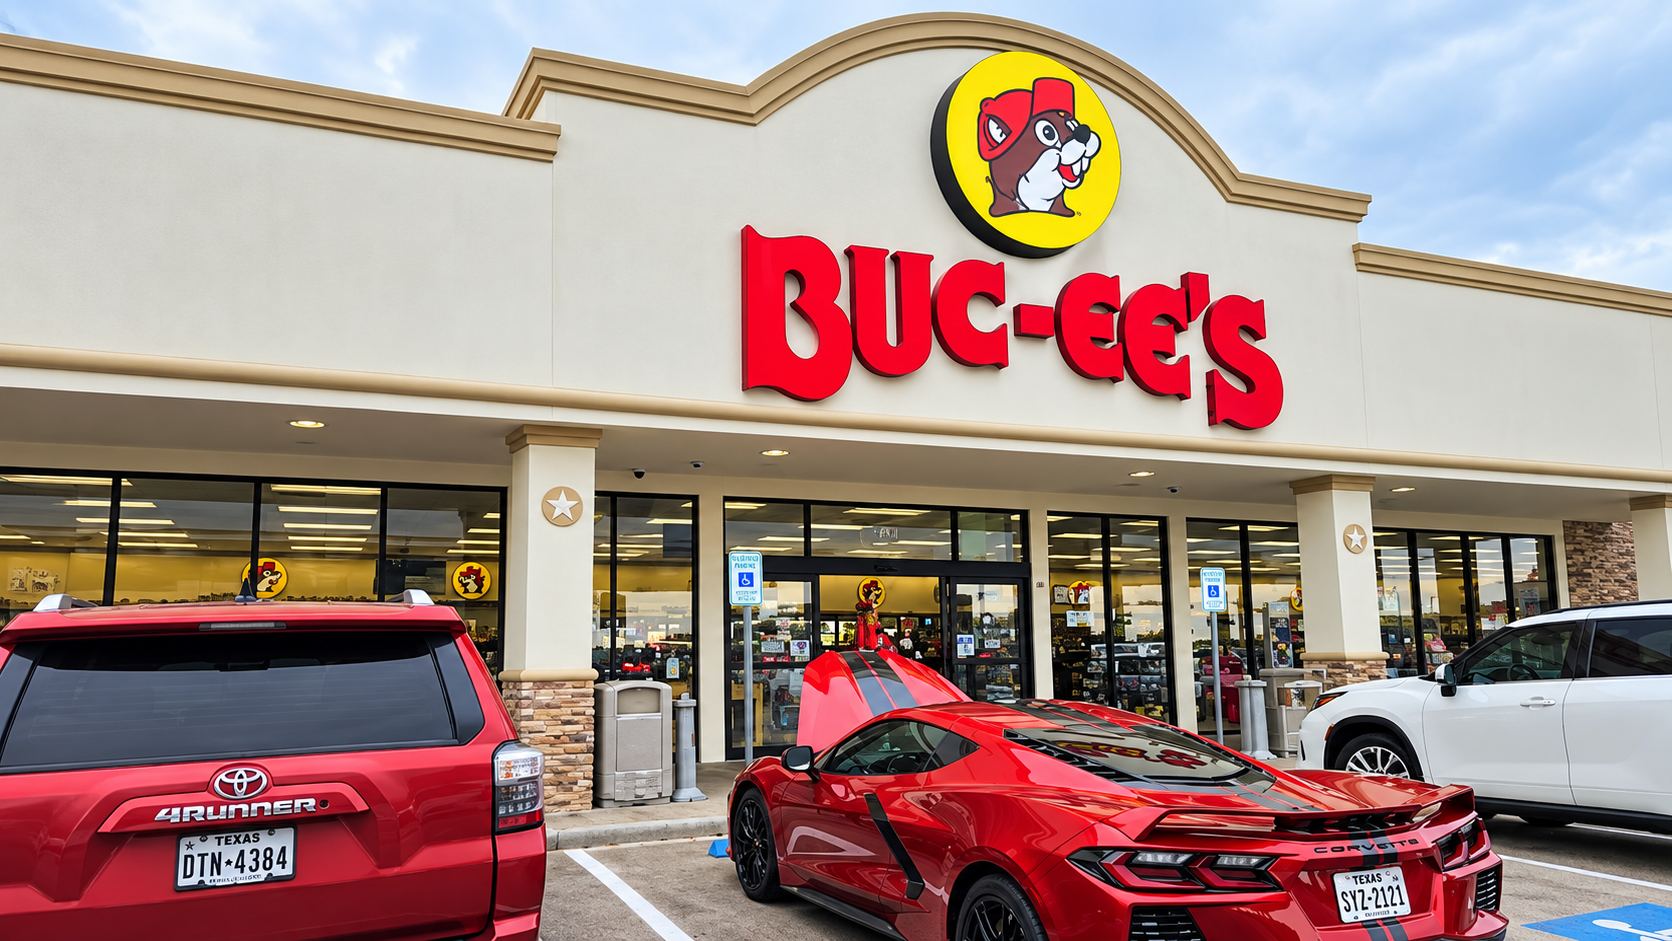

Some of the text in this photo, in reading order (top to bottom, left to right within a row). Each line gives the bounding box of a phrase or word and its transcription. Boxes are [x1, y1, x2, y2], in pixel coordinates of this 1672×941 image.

[741, 225, 1284, 431] BUC-EE'S
[154, 798, 316, 823] 4RUNNER
[215, 832, 261, 846] TEXAS
[1352, 873, 1383, 885] TEXAS
